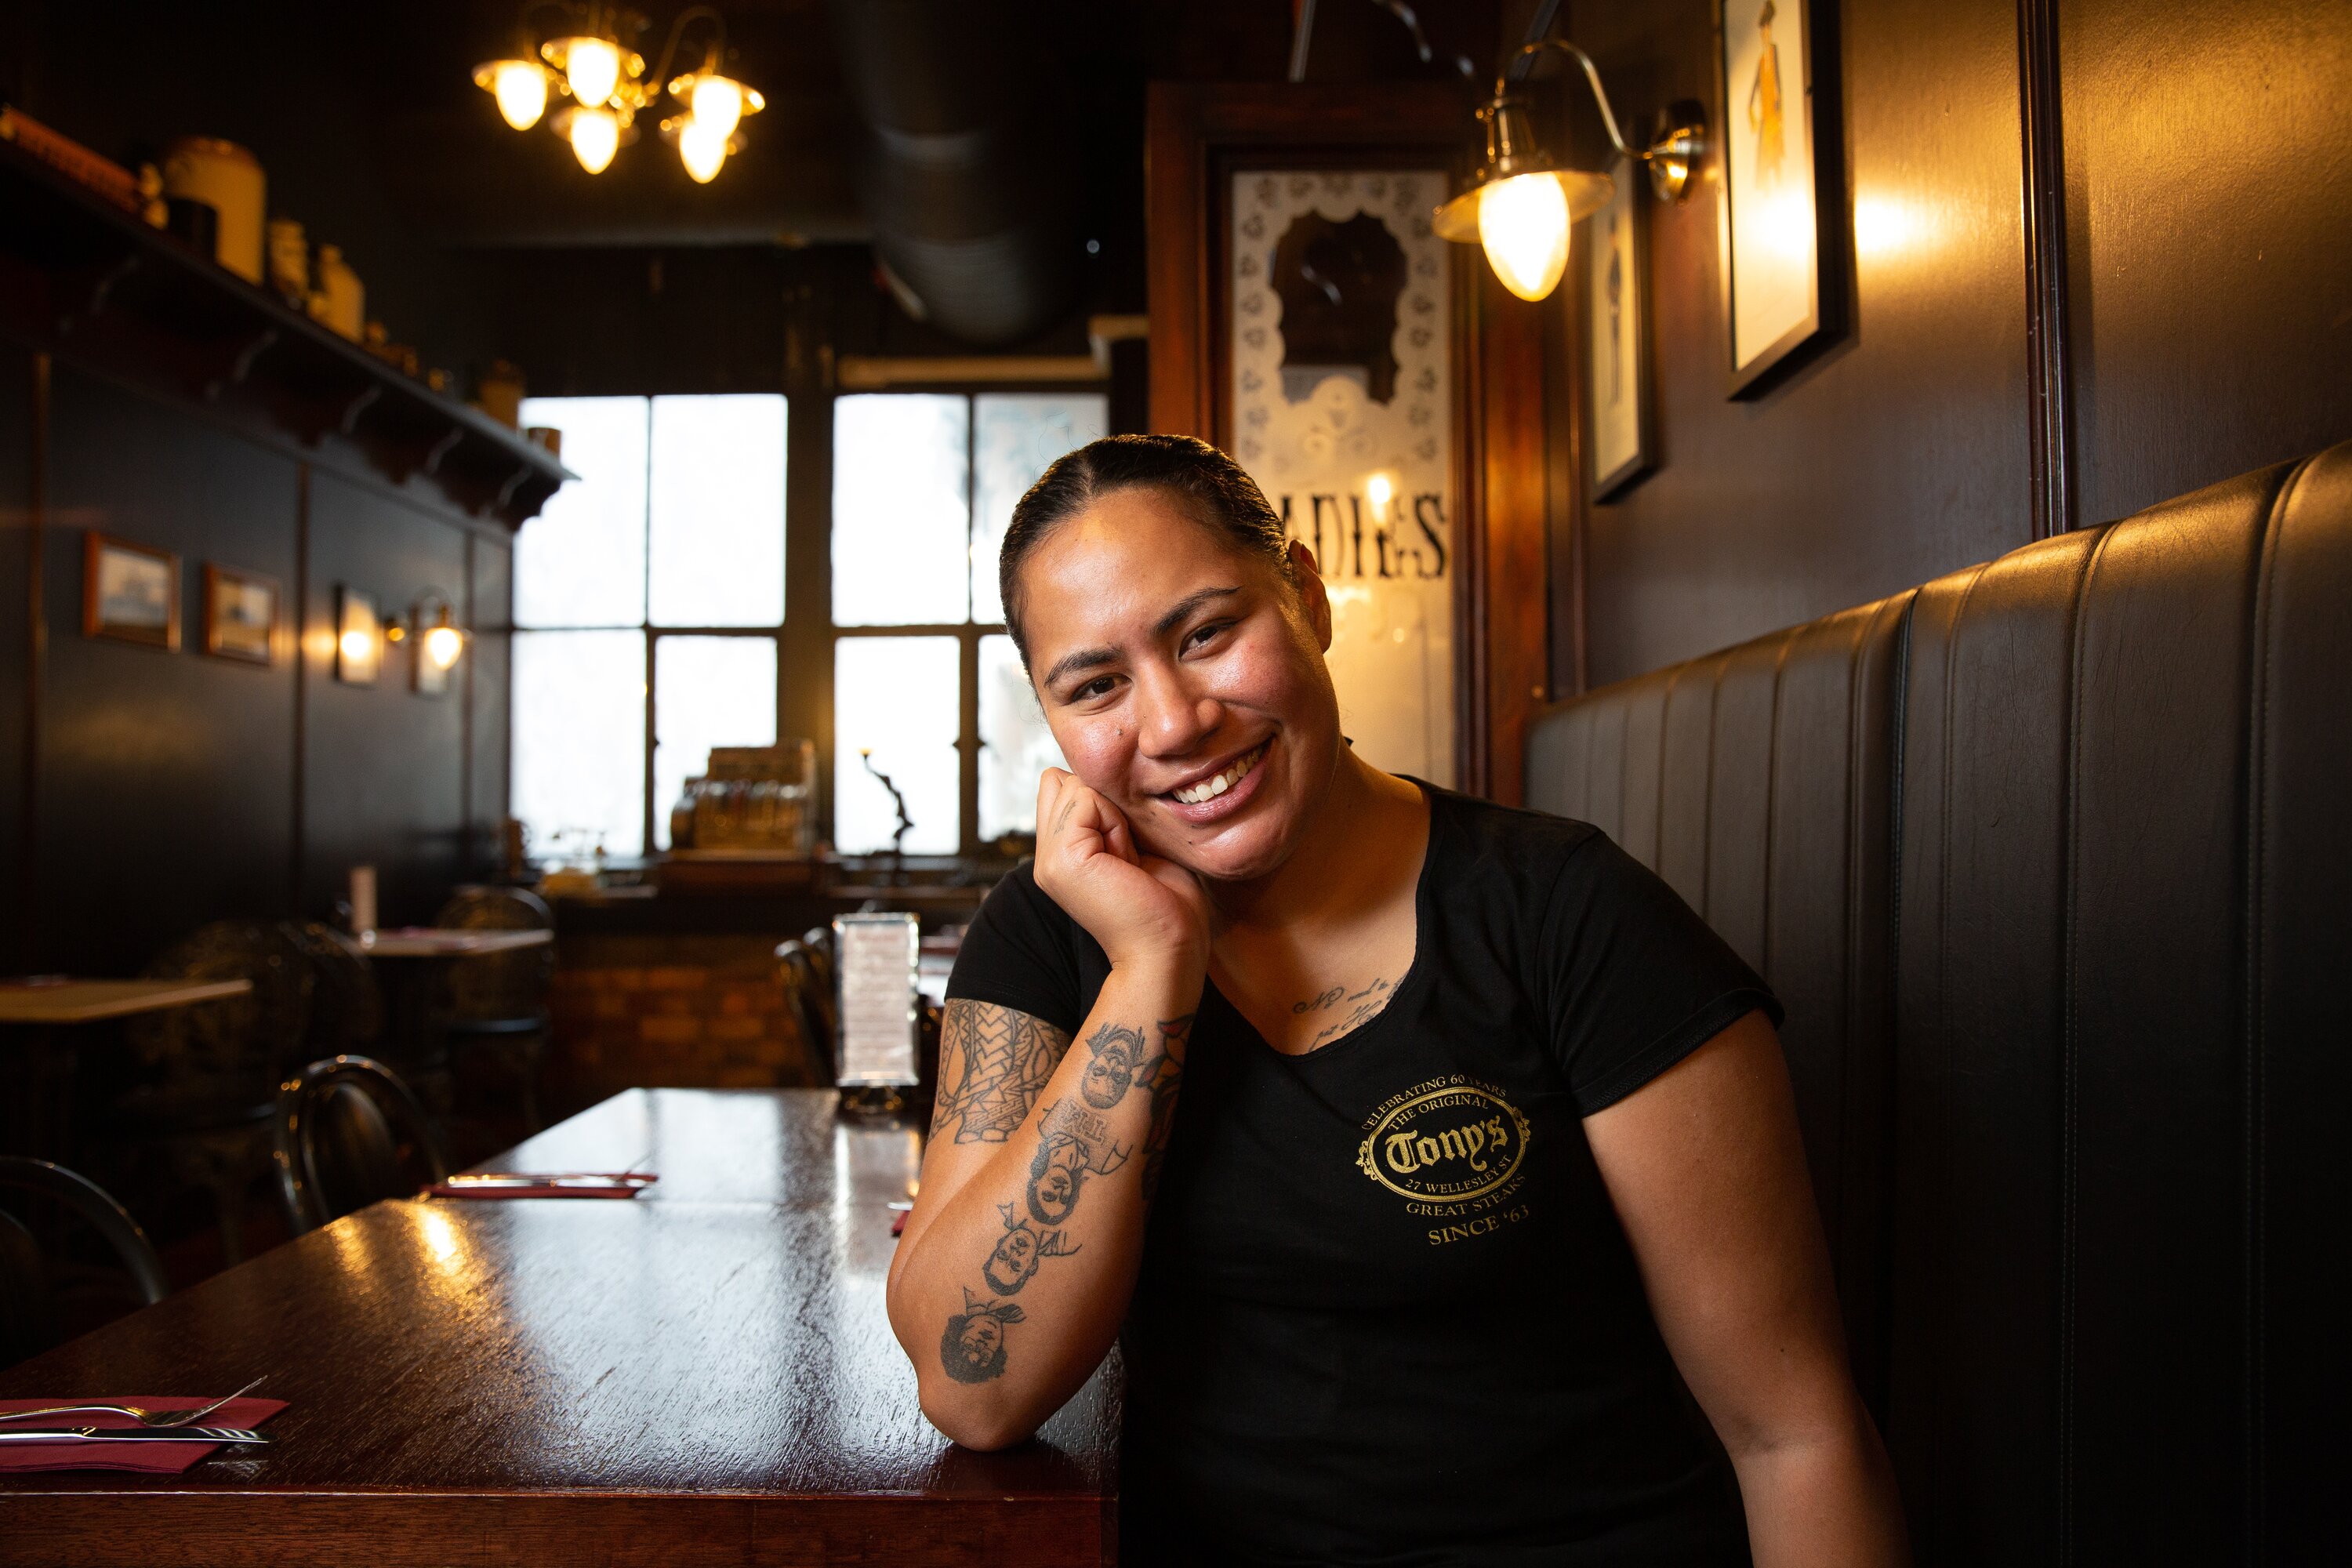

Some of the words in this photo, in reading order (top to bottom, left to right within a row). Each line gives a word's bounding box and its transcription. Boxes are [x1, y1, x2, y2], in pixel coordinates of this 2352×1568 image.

[1279, 494, 1447, 579] DIES
[1361, 1076, 1446, 1131] CELEBRATING
[1450, 1074, 1465, 1085] 60
[1468, 1076, 1507, 1098] YEARS
[1388, 1109, 1417, 1131] THE
[1418, 1094, 1490, 1114] ORIGINAL
[1385, 1115, 1508, 1174] Tony's
[1405, 1178, 1421, 1191] 27
[1425, 1167, 1500, 1193] WELLESLEY
[1497, 1154, 1512, 1171] ST
[1406, 1202, 1468, 1217] GREAT
[1472, 1174, 1526, 1212] STEAKS
[1428, 1215, 1500, 1246] SINCE
[1501, 1204, 1530, 1223] '63
